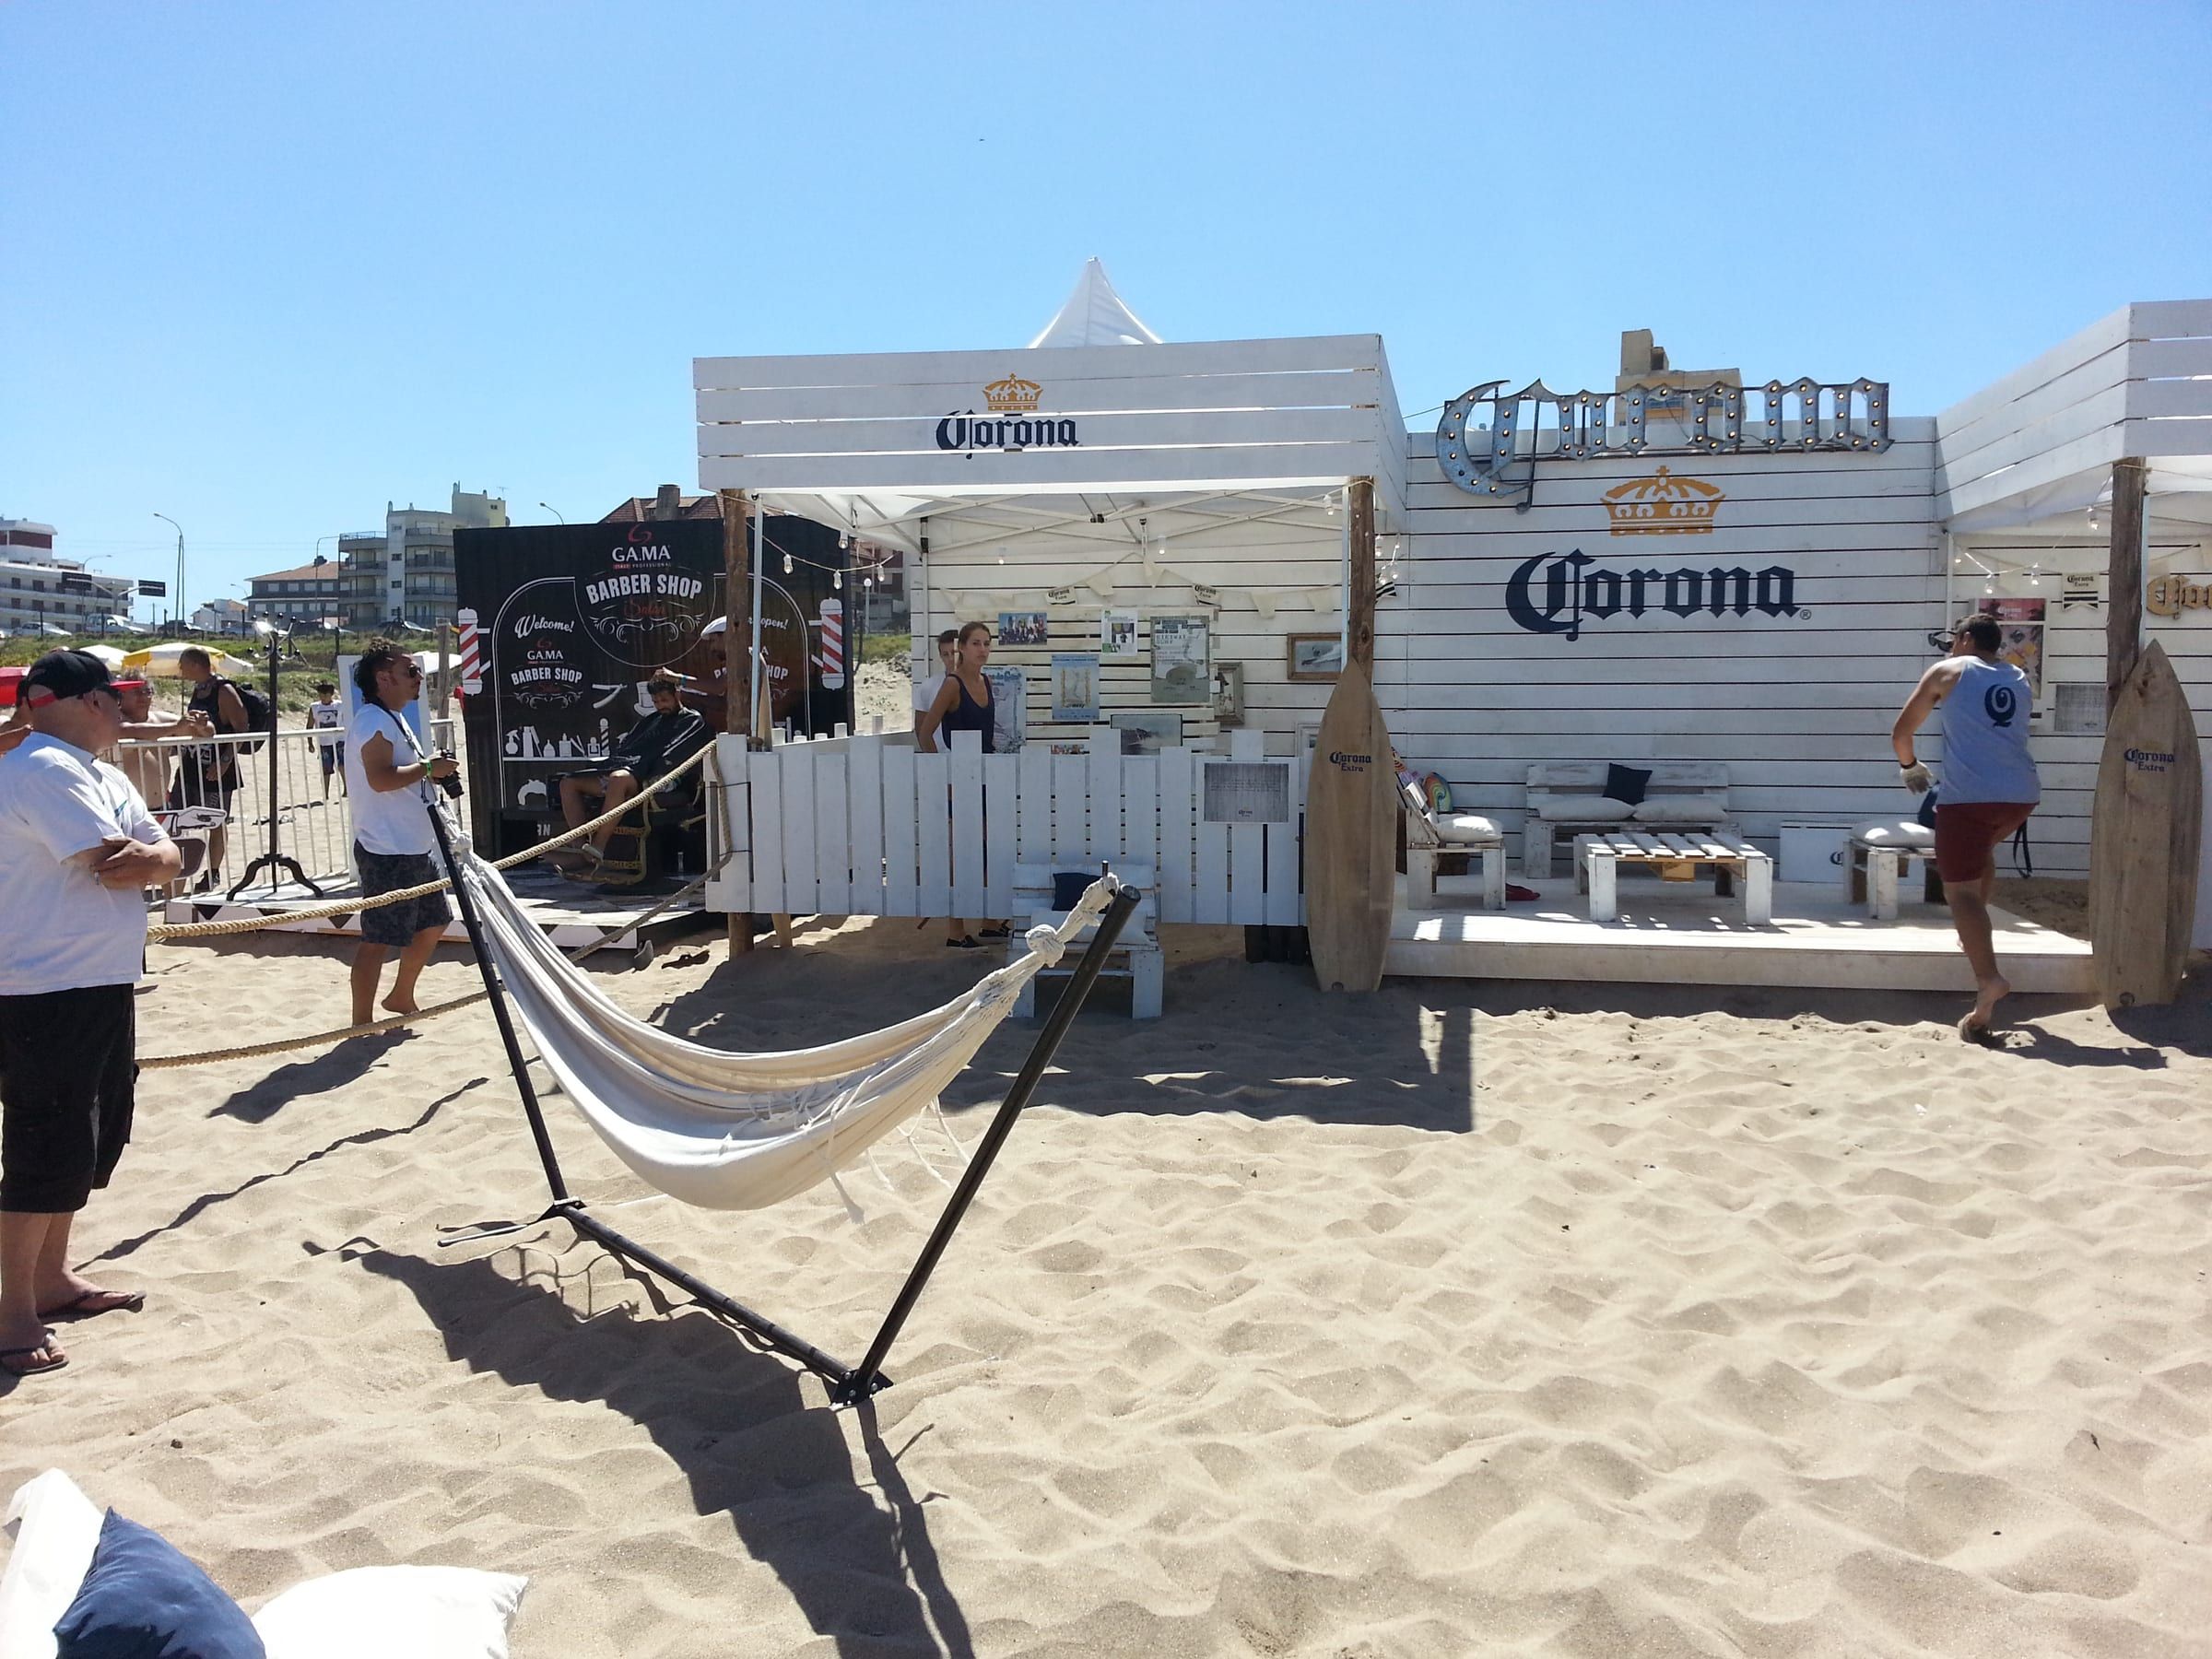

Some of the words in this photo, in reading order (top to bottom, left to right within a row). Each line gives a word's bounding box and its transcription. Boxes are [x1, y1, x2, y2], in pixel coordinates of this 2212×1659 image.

[935, 409, 1079, 460] Corona
[1436, 376, 1896, 515] Corona
[585, 573, 651, 605] BARBER
[656, 573, 702, 599] SHOP
[1505, 547, 1802, 642] Corona
[514, 614, 574, 639] Welcome!
[511, 667, 551, 686] BARBER
[554, 667, 582, 683] SHOP
[1329, 751, 1371, 767] Corona
[2124, 747, 2175, 764] Corona
